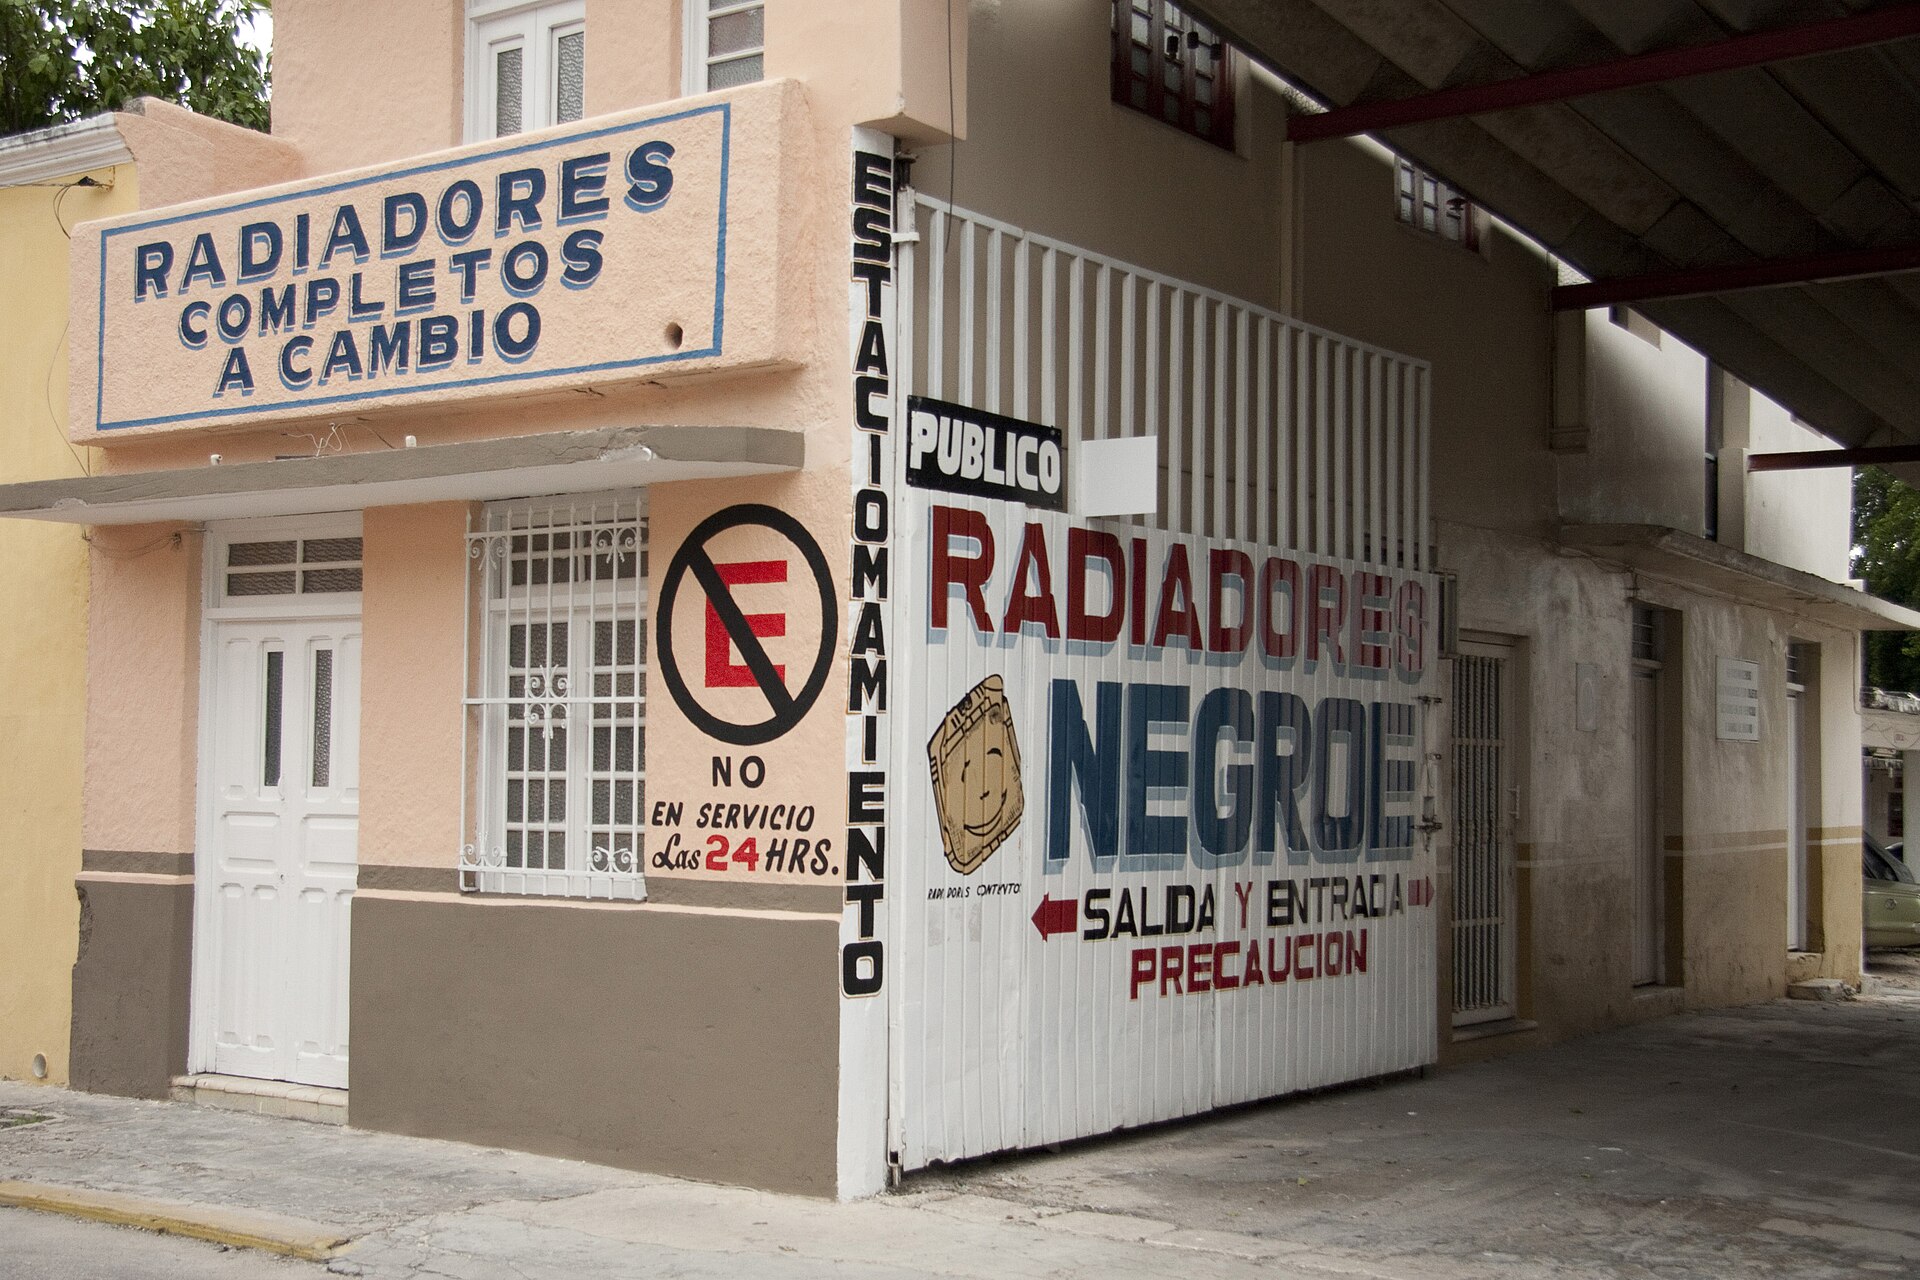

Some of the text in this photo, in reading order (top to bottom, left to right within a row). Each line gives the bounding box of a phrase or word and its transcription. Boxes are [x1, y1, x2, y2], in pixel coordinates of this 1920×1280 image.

[134, 140, 676, 302] RADIADORES
[178, 229, 605, 349] COMPLETOS
[213, 302, 541, 397] A CAMBIO
[910, 412, 1061, 494] PUBLICO
[926, 505, 1430, 685] RADIADORES
[712, 755, 766, 788] NO
[1043, 679, 1417, 875] NEGROE
[651, 801, 815, 831] EN SERVICIO
[652, 833, 839, 876] Las 24 HRS.
[1234, 881, 1254, 929] Y
[1266, 873, 1404, 927] ENTRADA
[1130, 929, 1368, 999] PRECAUCION
